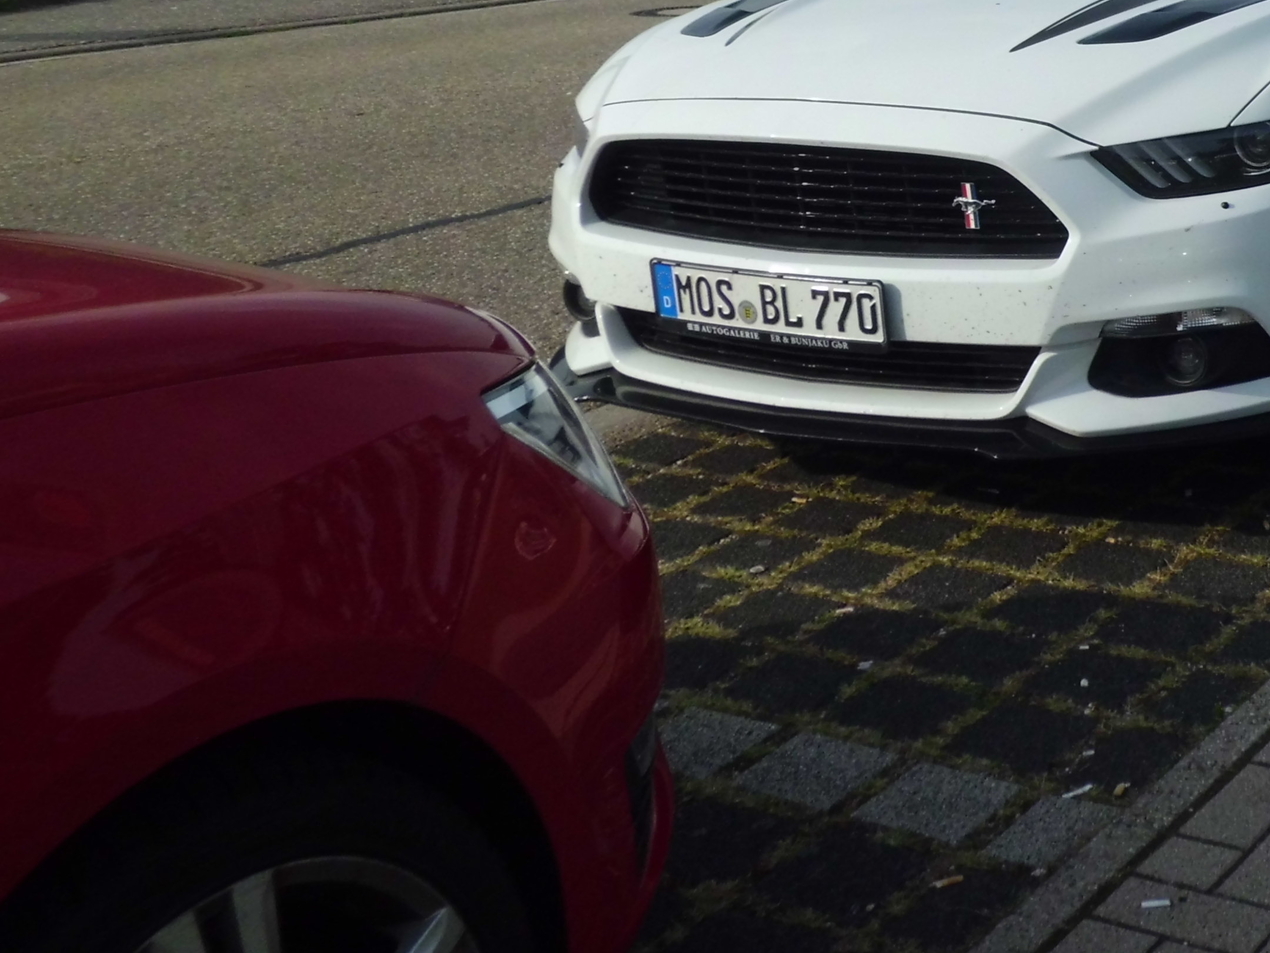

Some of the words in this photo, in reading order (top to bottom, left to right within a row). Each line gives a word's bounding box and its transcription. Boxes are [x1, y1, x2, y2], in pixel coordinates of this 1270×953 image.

[663, 296, 671, 308] D
[674, 273, 736, 320] MOS
[758, 283, 803, 328] BL
[811, 287, 879, 335] 770
[701, 326, 760, 340] AUTOGALERIE
[782, 335, 790, 344] &
[791, 336, 829, 348] BUNJAKU
